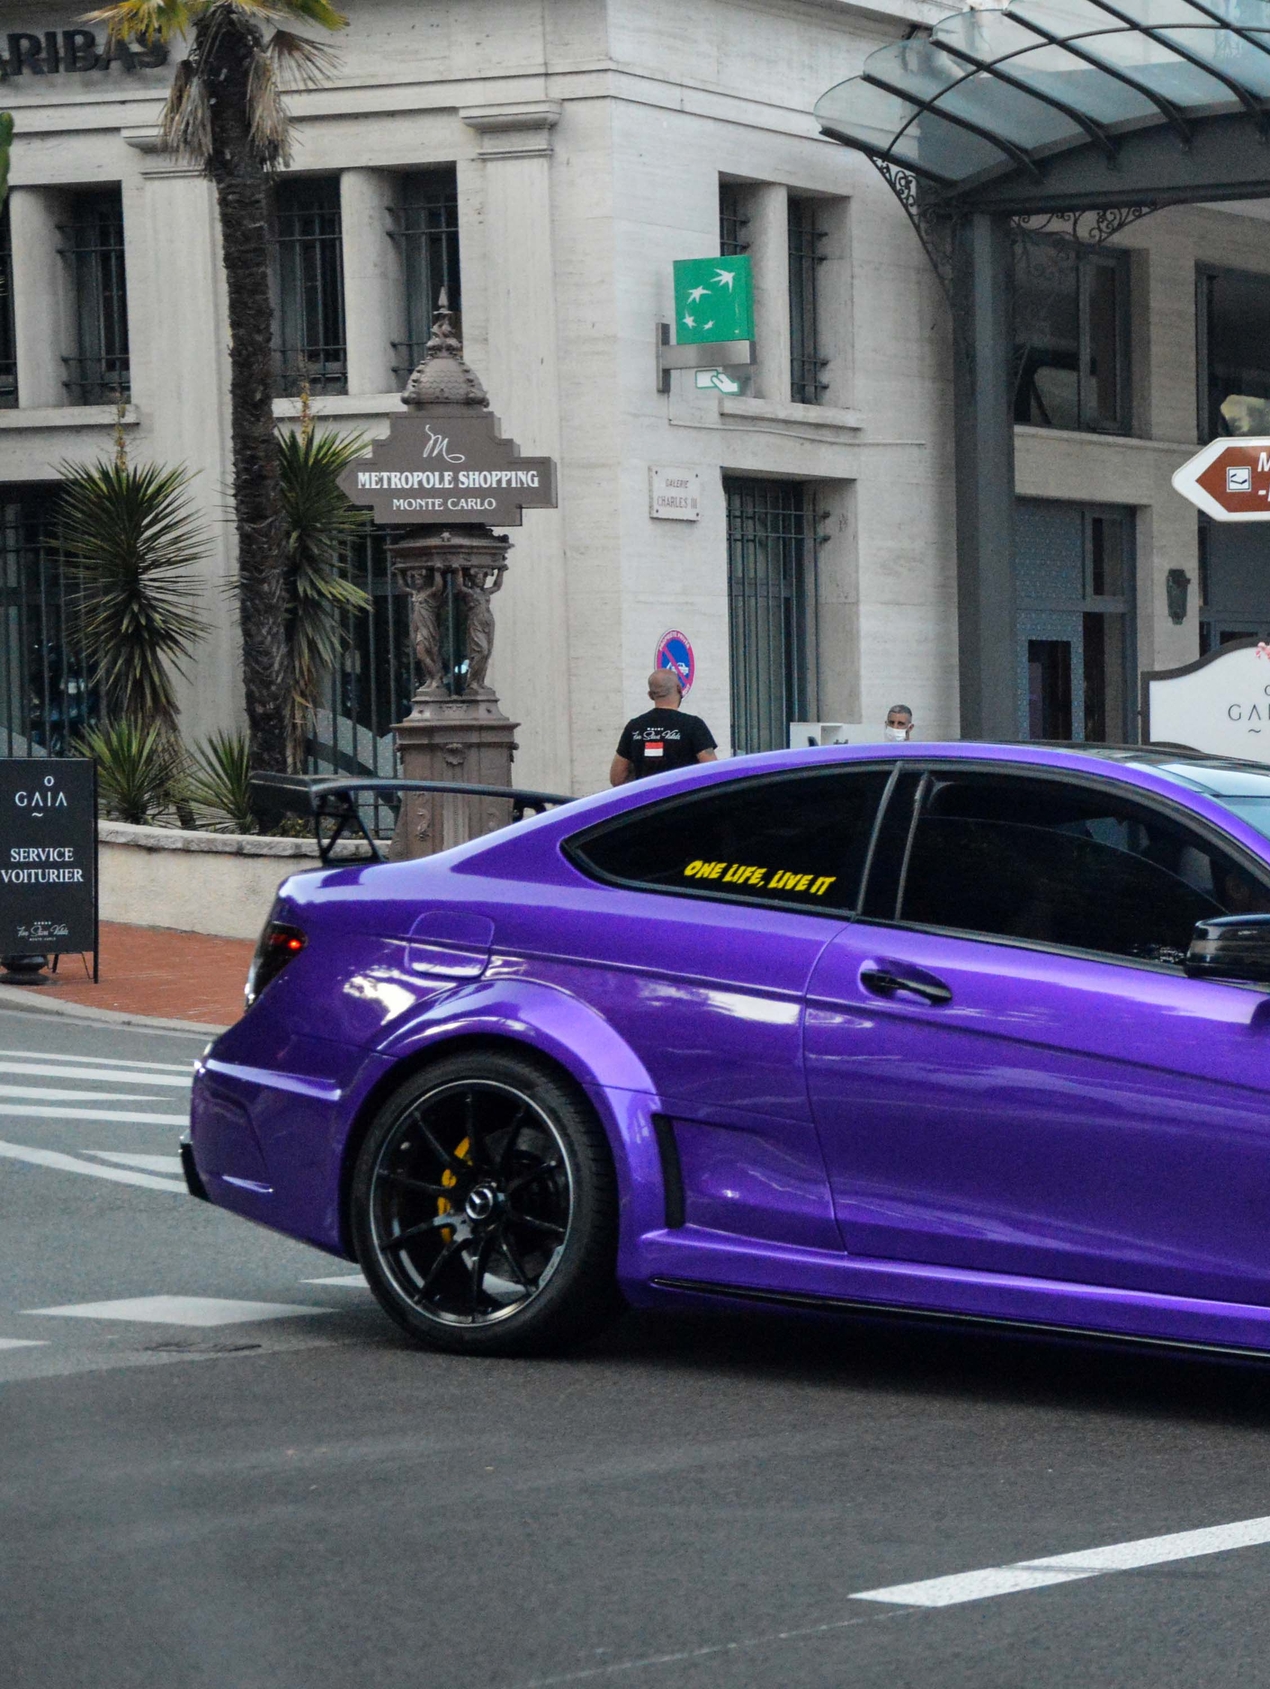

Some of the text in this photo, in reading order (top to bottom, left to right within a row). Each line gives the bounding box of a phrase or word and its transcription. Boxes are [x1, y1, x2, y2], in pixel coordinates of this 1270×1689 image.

[0, 26, 169, 77] RIBAS
[357, 471, 539, 489] METROPOLE SHOPPING
[392, 498, 496, 510] MONTE CARLO
[657, 495, 688, 508] CHARLES
[14, 791, 68, 807] GAIA
[10, 848, 74, 862] SERVICE
[0, 868, 84, 883] VOITURIER
[684, 860, 837, 895] ONE LIFE, LIVE IT
